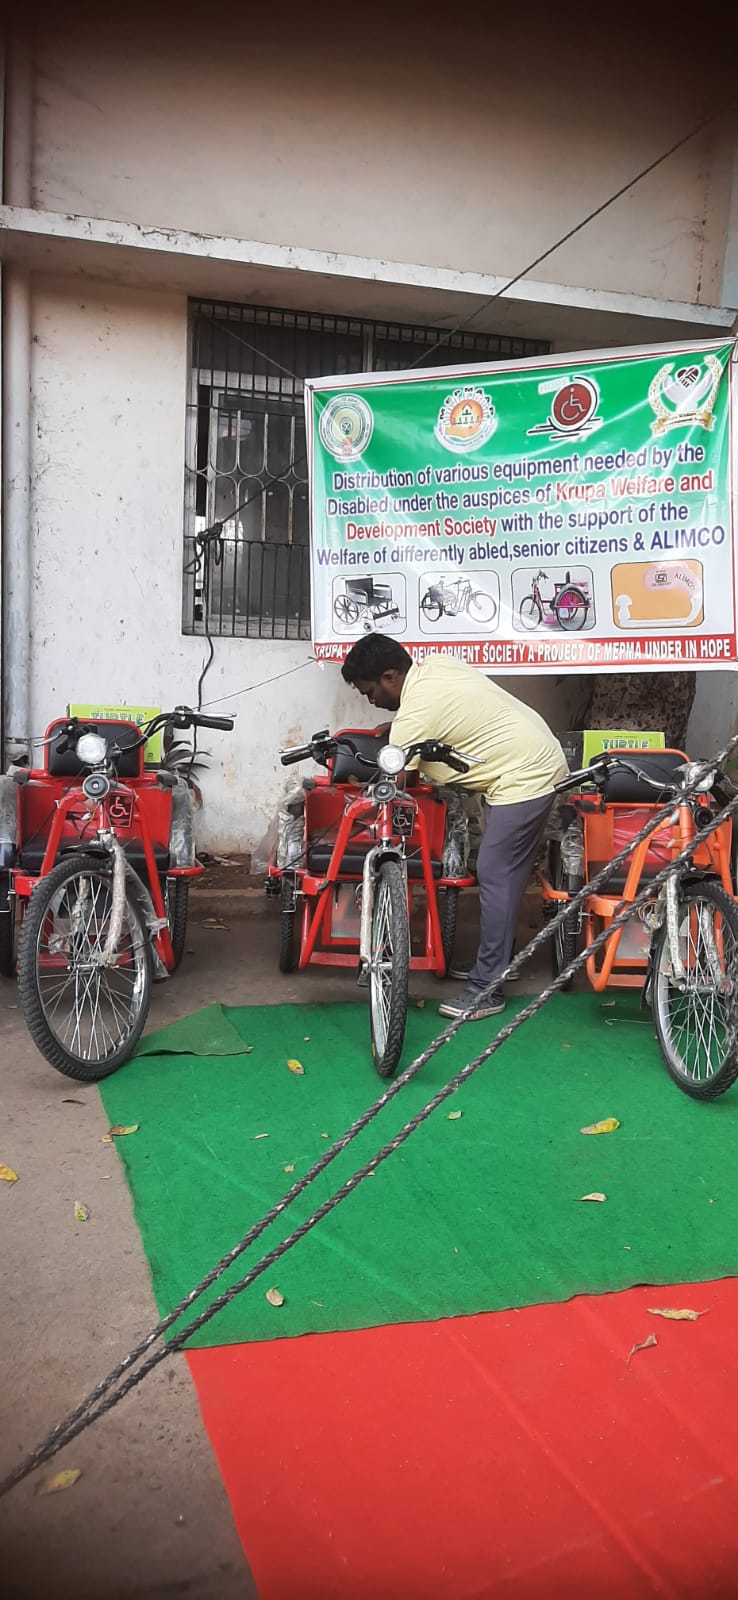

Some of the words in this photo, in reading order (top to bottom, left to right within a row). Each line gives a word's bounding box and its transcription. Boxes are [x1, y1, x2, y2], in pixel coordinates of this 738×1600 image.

[334, 469, 413, 491] Distribution
[417, 466, 432, 485] of
[435, 463, 489, 484] various
[493, 454, 579, 482] equipment
[584, 448, 647, 471] needed
[652, 446, 672, 468] by
[677, 442, 704, 463] the
[327, 495, 388, 516] Disabled
[393, 493, 432, 513] under
[436, 491, 458, 510] the
[463, 487, 530, 510] auspices
[535, 483, 551, 503] of
[555, 482, 605, 504] Krupa
[610, 475, 675, 498] Welfare
[680, 470, 713, 492] and
[346, 520, 441, 541] Development
[444, 516, 497, 538] Society
[501, 513, 533, 533] with
[538, 514, 563, 530] the
[568, 506, 633, 530] support
[638, 503, 655, 522] of
[660, 502, 689, 521] the
[317, 546, 370, 566] Welfare
[373, 546, 387, 564] of
[391, 543, 464, 565] differently
[469, 538, 560, 561] abled,senior
[565, 535, 628, 556] citizens
[633, 532, 645, 551] &
[650, 525, 725, 550] ALIMCO
[482, 643, 527, 663] SOCIETY
[527, 646, 535, 662] A
[537, 644, 585, 662] PROJECT
[587, 644, 601, 661] OF
[604, 641, 641, 660] MEPMA
[645, 640, 682, 659] UNDER
[685, 640, 697, 658] IN
[701, 638, 730, 658] HOPE
